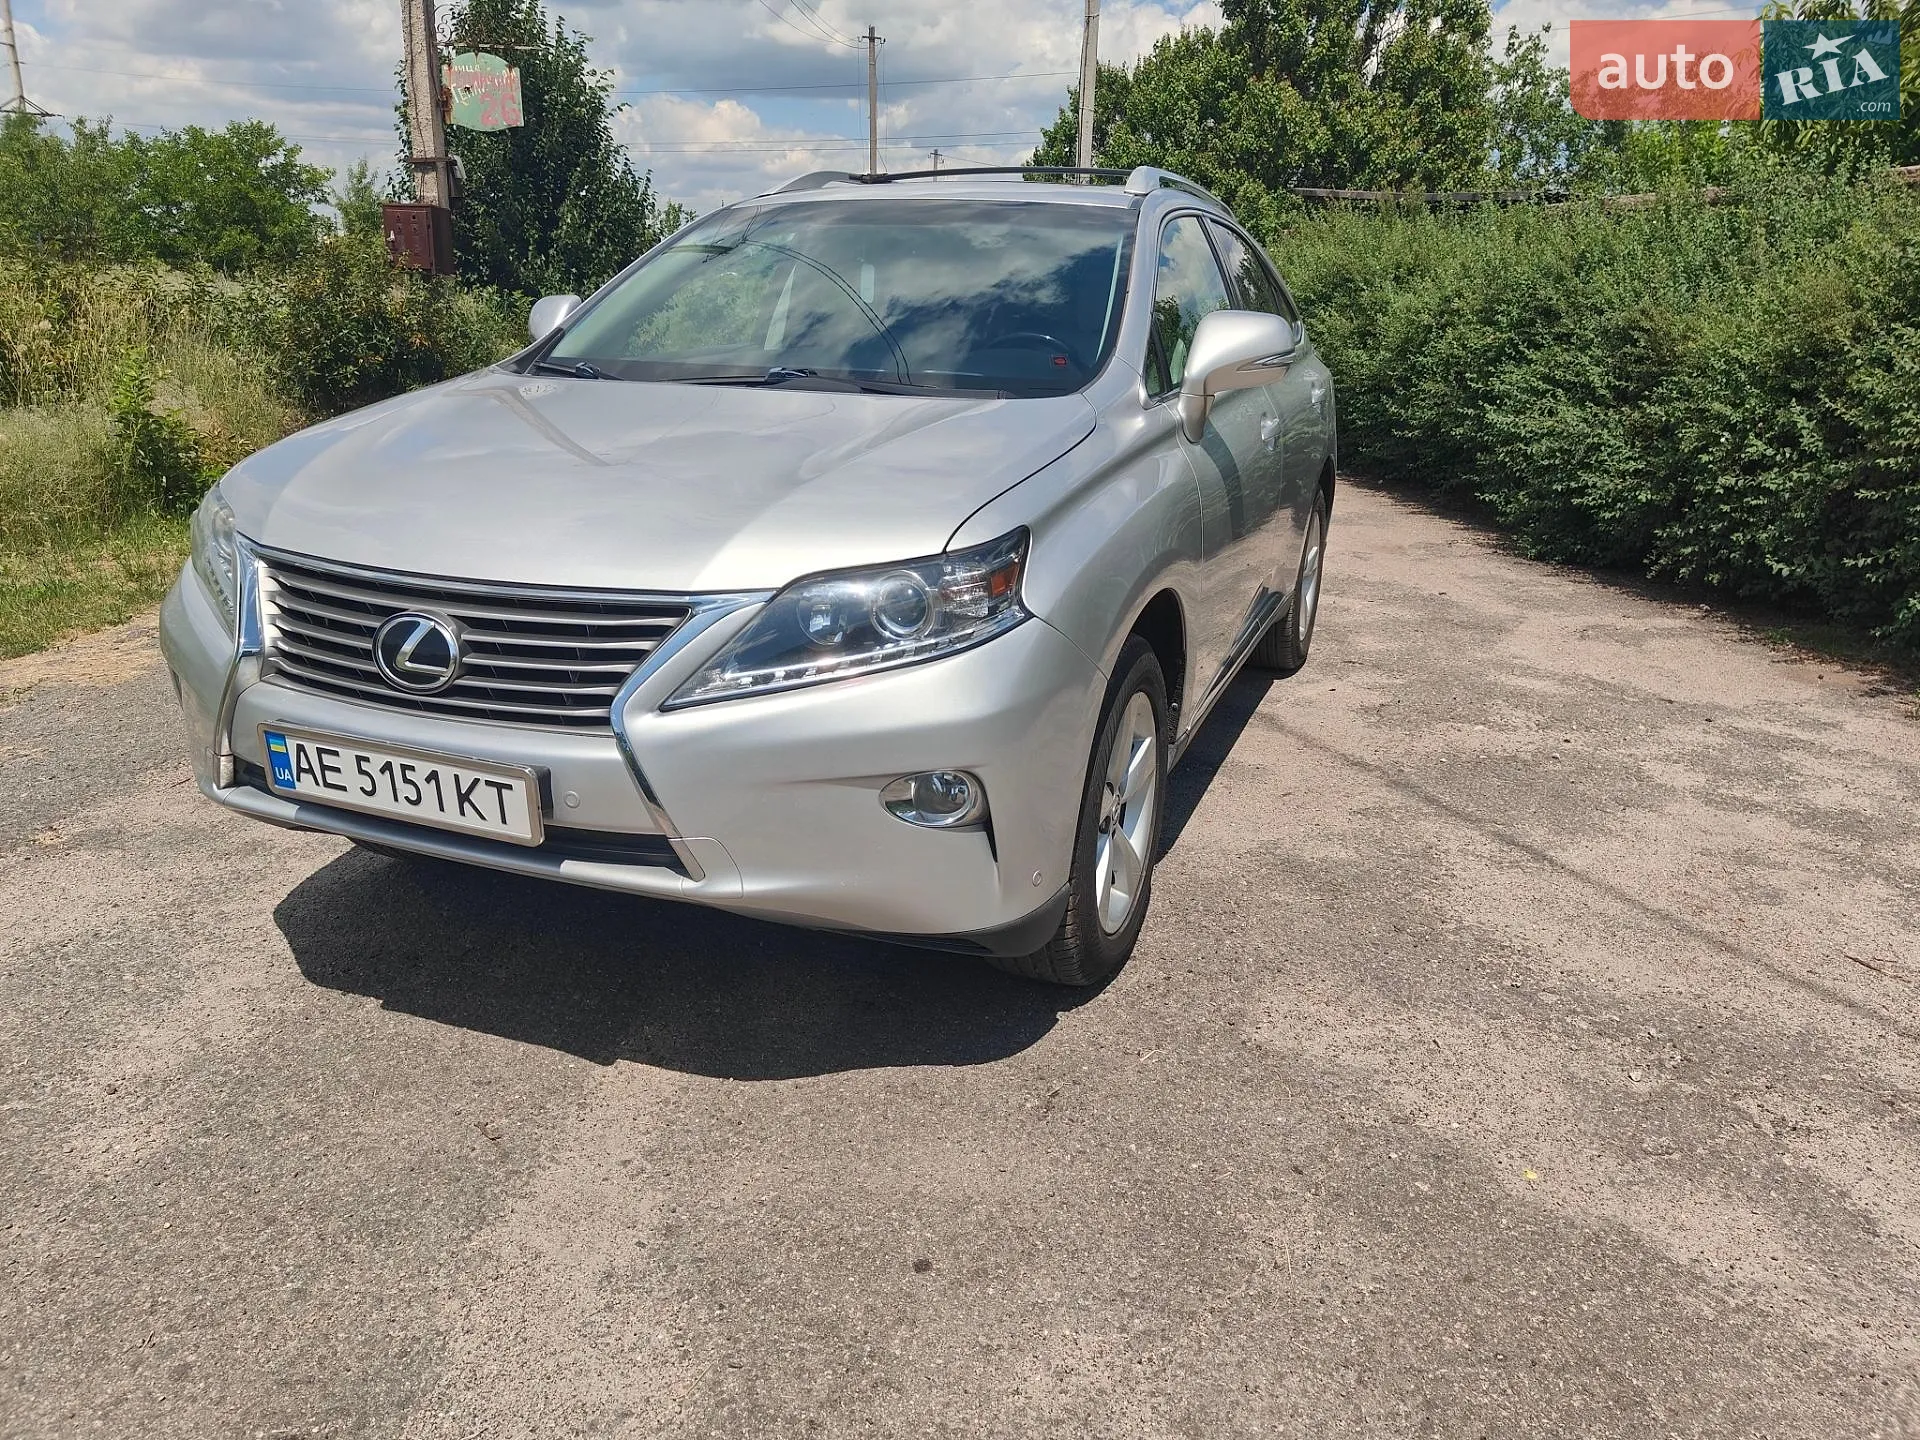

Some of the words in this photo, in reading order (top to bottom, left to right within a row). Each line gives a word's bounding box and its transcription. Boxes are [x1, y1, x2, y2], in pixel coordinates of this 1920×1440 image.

[480, 92, 521, 127] 26
[274, 766, 293, 782] UA
[295, 743, 348, 792] AE
[354, 754, 446, 813] 5151
[453, 773, 514, 825] KT
